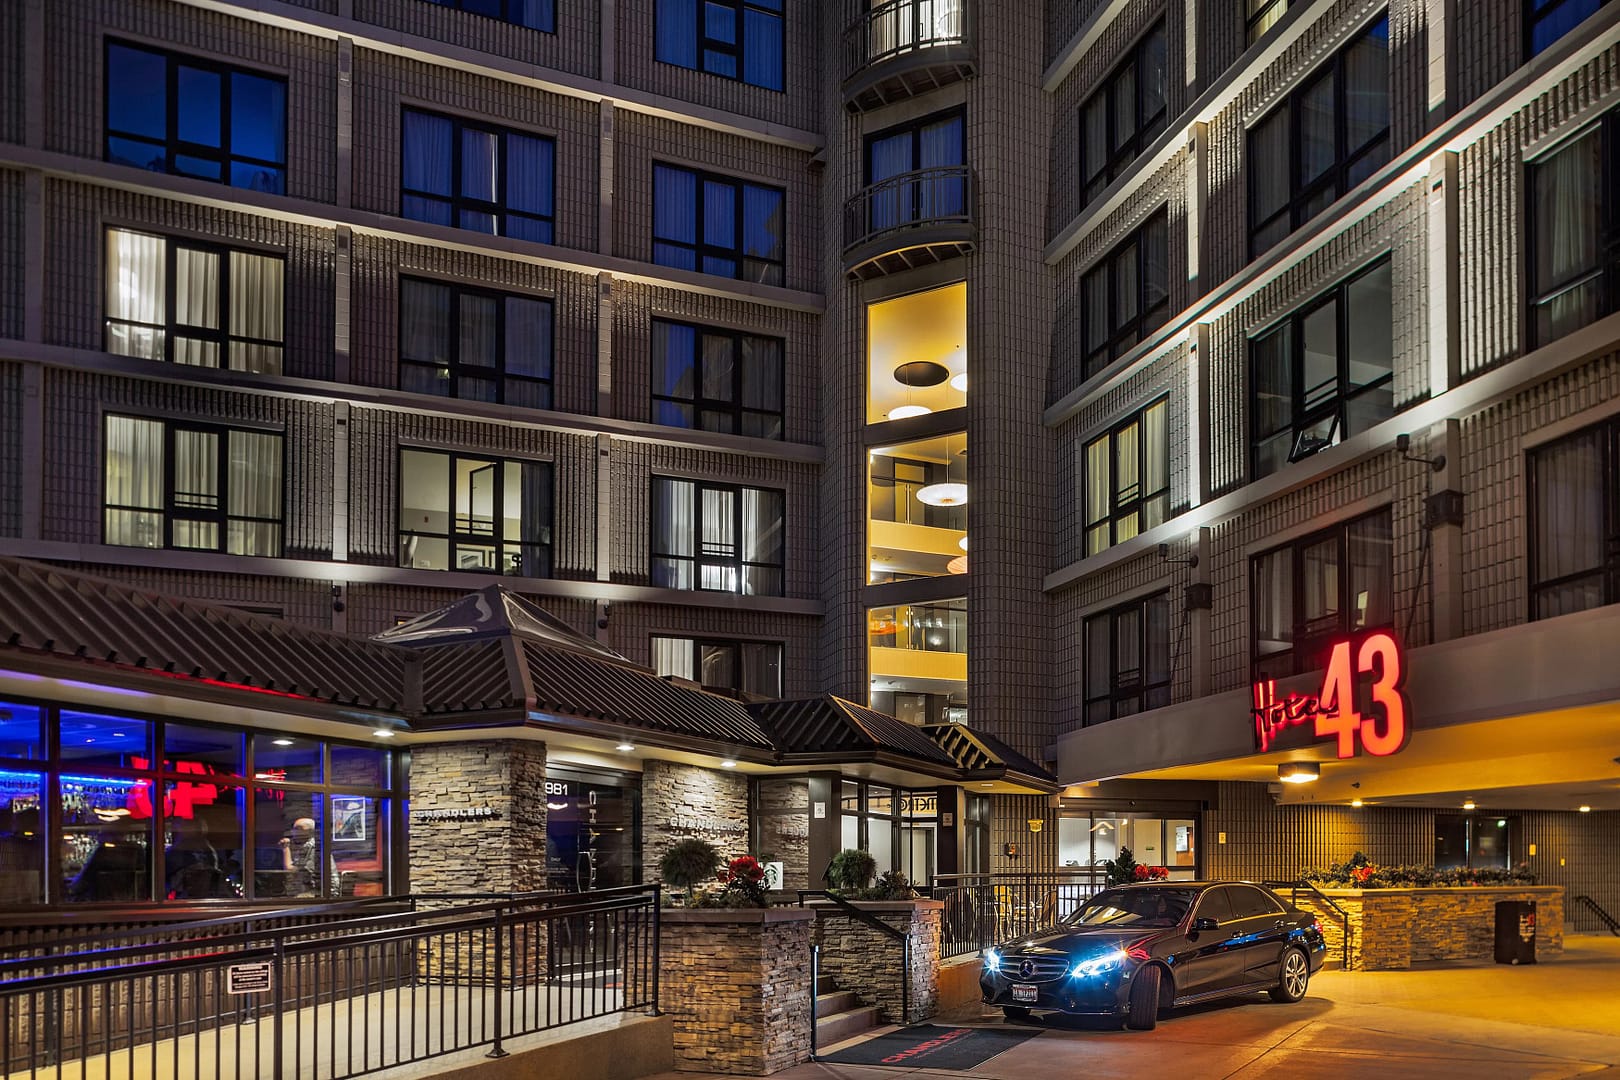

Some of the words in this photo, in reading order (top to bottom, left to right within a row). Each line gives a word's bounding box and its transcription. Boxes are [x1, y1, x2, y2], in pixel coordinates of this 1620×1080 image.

[1315, 633, 1404, 759] 43
[545, 782, 568, 796] 981
[415, 807, 492, 818] CHANDLERS
[670, 815, 743, 831] CHANDLERS
